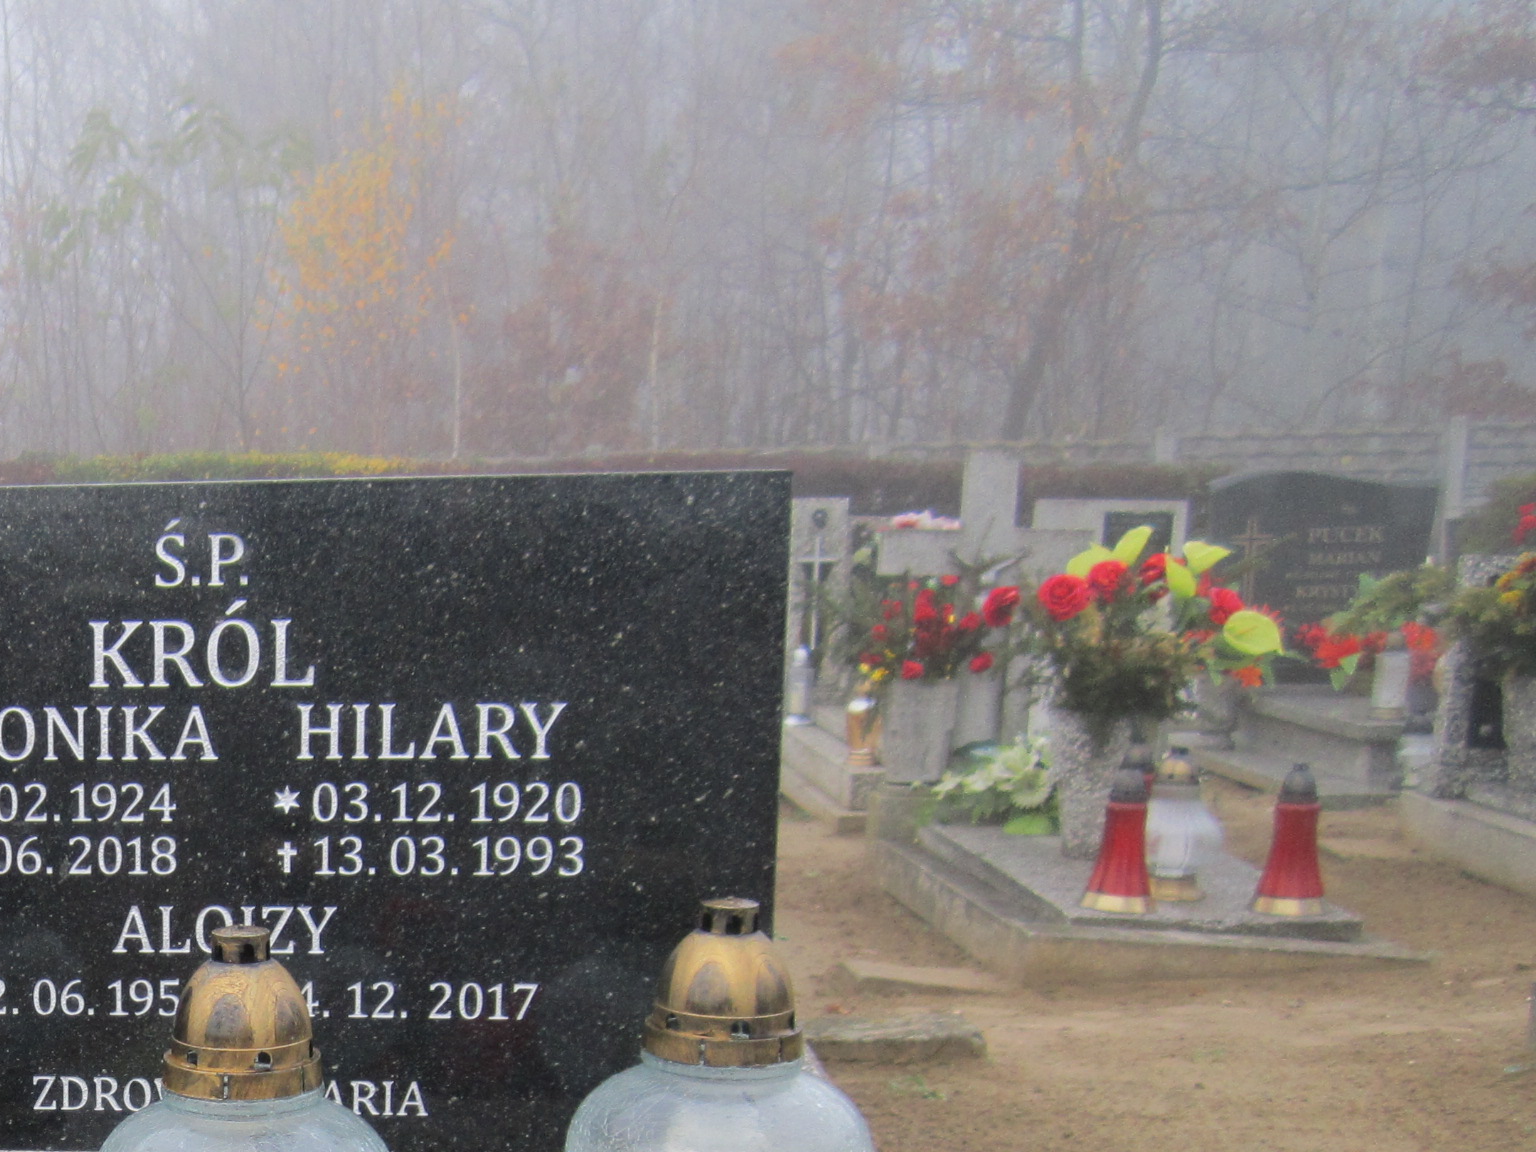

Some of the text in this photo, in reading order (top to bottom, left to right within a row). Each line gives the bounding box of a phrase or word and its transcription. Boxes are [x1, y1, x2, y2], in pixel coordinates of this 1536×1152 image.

[153, 518, 250, 588] Ś.P.
[88, 599, 316, 689] KRÓL
[295, 701, 568, 761] HILARY
[31, 1074, 429, 1117] ZDRO ARIA
